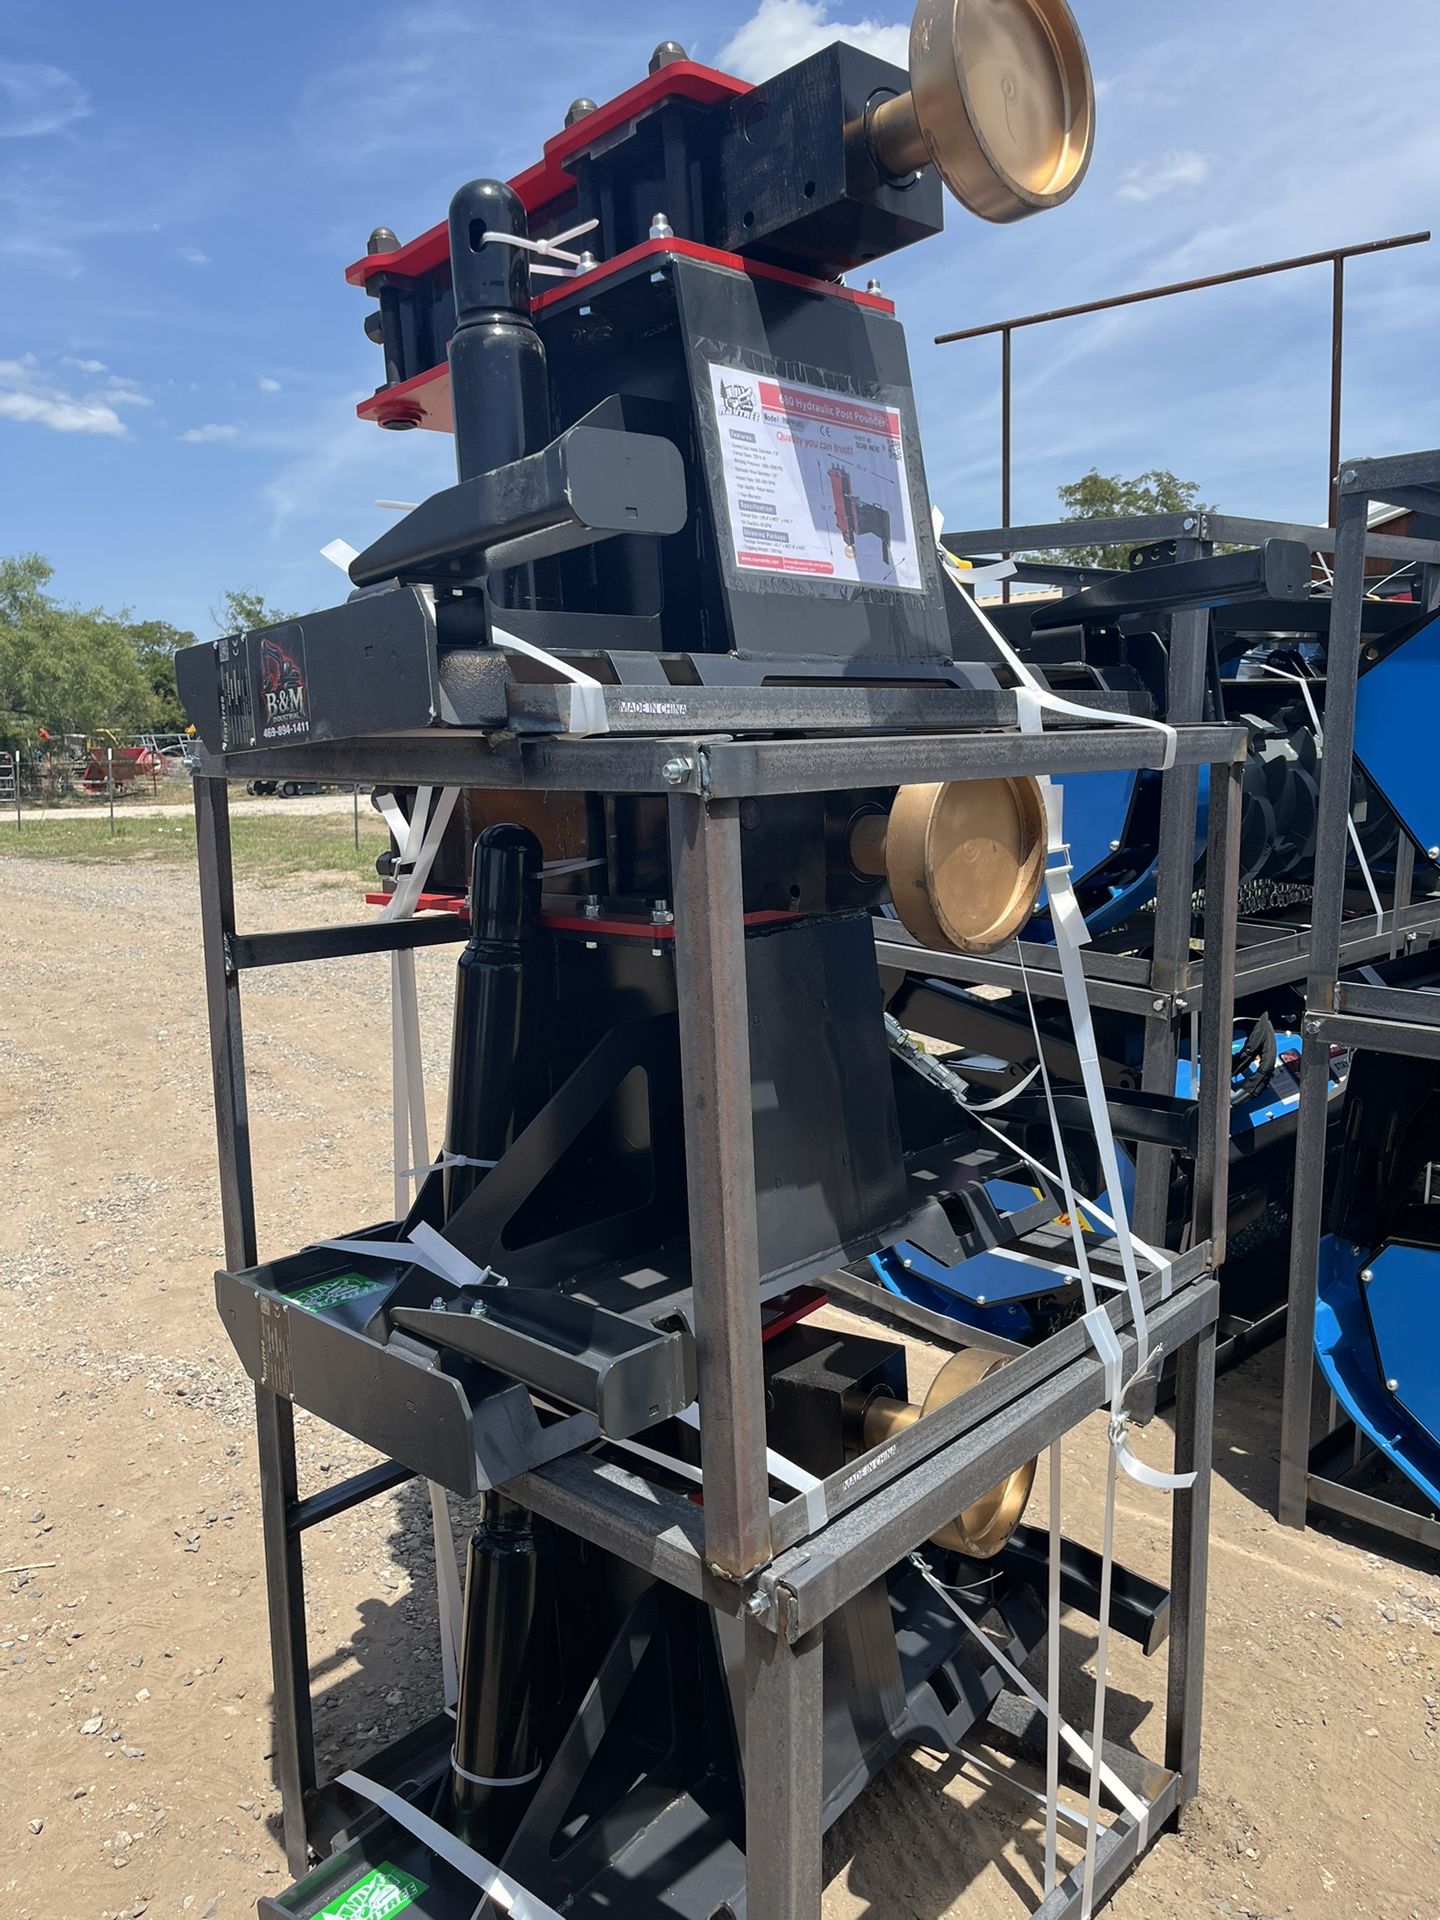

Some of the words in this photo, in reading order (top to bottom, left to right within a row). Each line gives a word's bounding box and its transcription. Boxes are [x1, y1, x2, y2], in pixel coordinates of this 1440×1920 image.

[778, 393, 794, 406] 680
[795, 397, 833, 418] Hydraulic
[835, 406, 852, 420] Post
[854, 410, 885, 428] Pounder
[776, 431, 803, 447] Quality
[803, 438, 819, 450] you
[818, 441, 833, 452] can
[619, 702, 646, 713] MADE
[648, 703, 658, 714] IN
[660, 703, 687, 715] CHINA
